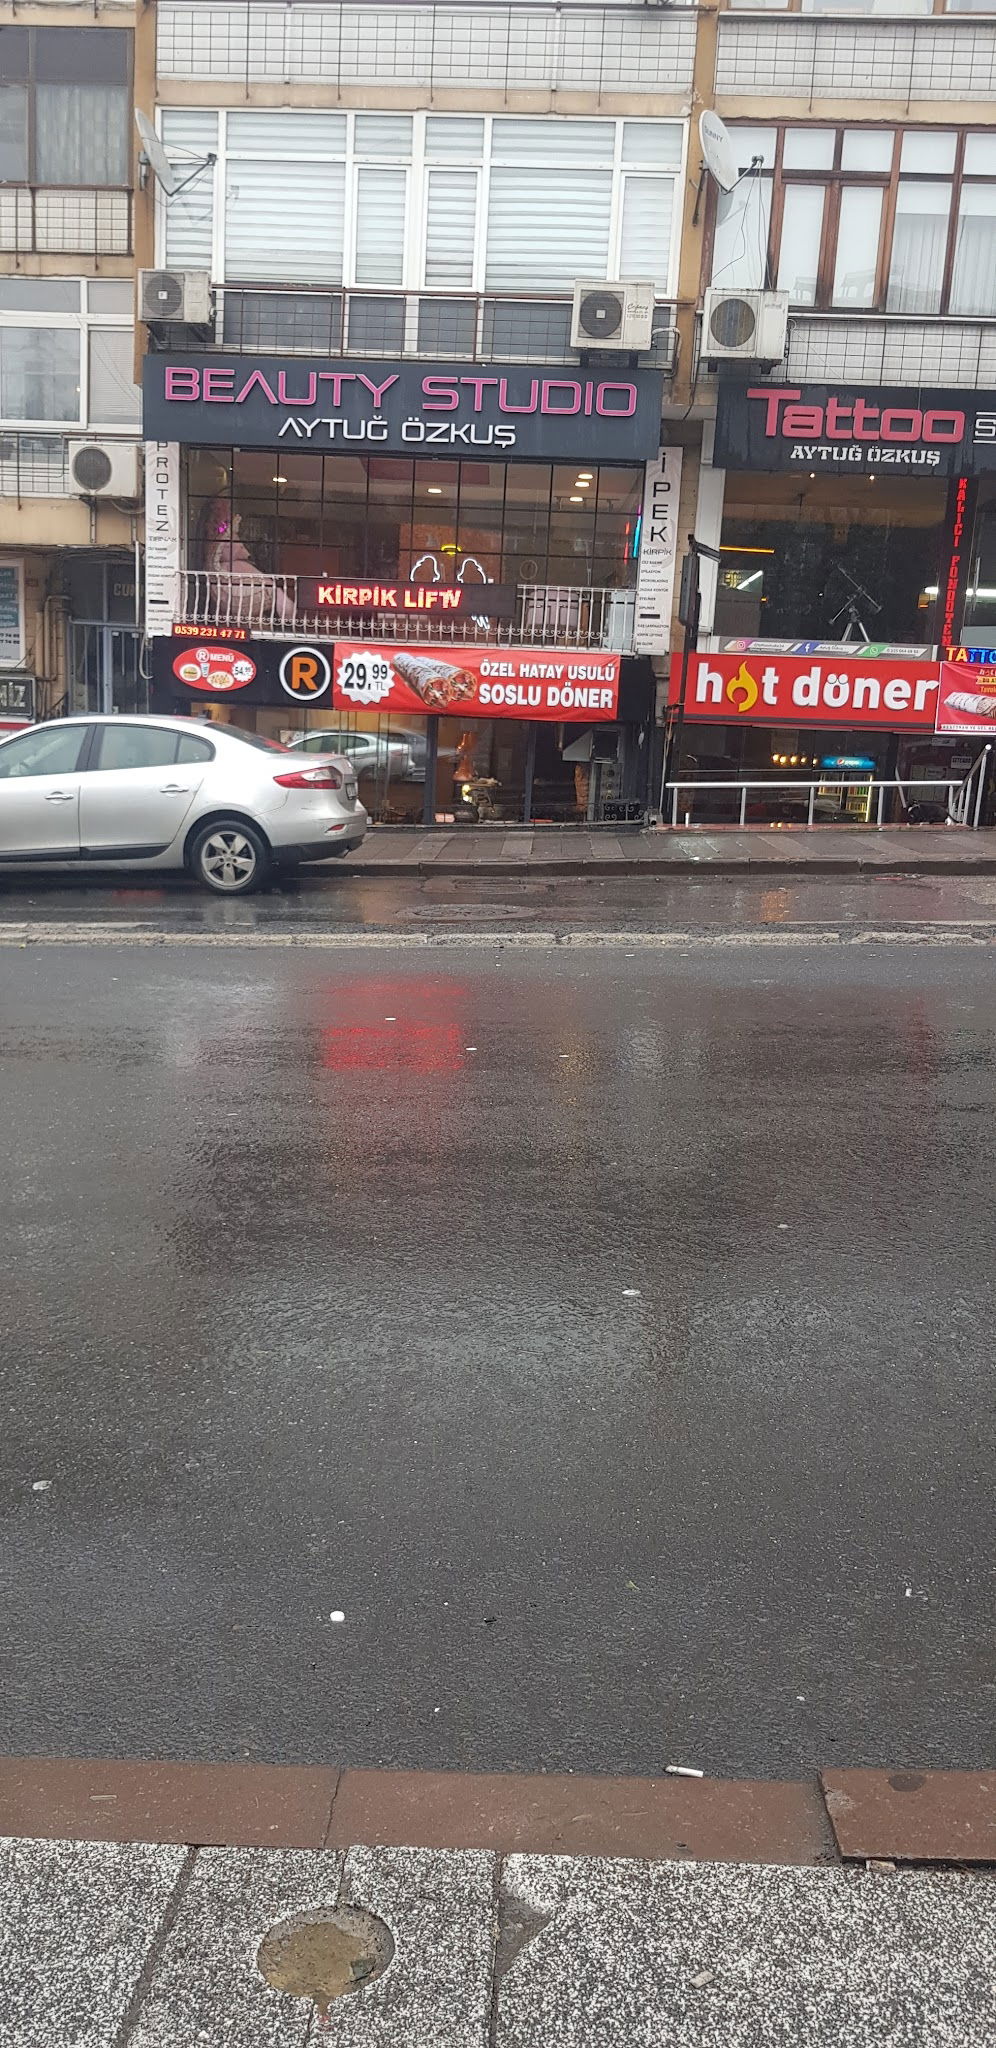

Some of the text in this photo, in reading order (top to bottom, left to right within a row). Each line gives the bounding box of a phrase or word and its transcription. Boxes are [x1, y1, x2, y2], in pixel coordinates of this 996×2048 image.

[165, 366, 638, 417] BEAUTY STUDIO
[278, 415, 516, 449] AYTUĞ ÖZKUŞ
[747, 388, 966, 443] Tattoo
[790, 444, 941, 467] AYTUĞ ÖZKUŞ
[156, 441, 169, 531] PROTEZ
[650, 452, 671, 542] İPEK
[318, 584, 397, 607] KİRPİK
[174, 625, 246, 639] 0539 231 47 71
[291, 656, 318, 690] R
[375, 681, 387, 692] TL
[480, 659, 616, 682] ÖZEL HATAY USULÜ
[478, 682, 614, 709] SOSLU DÖNER
[791, 666, 940, 711] döner
